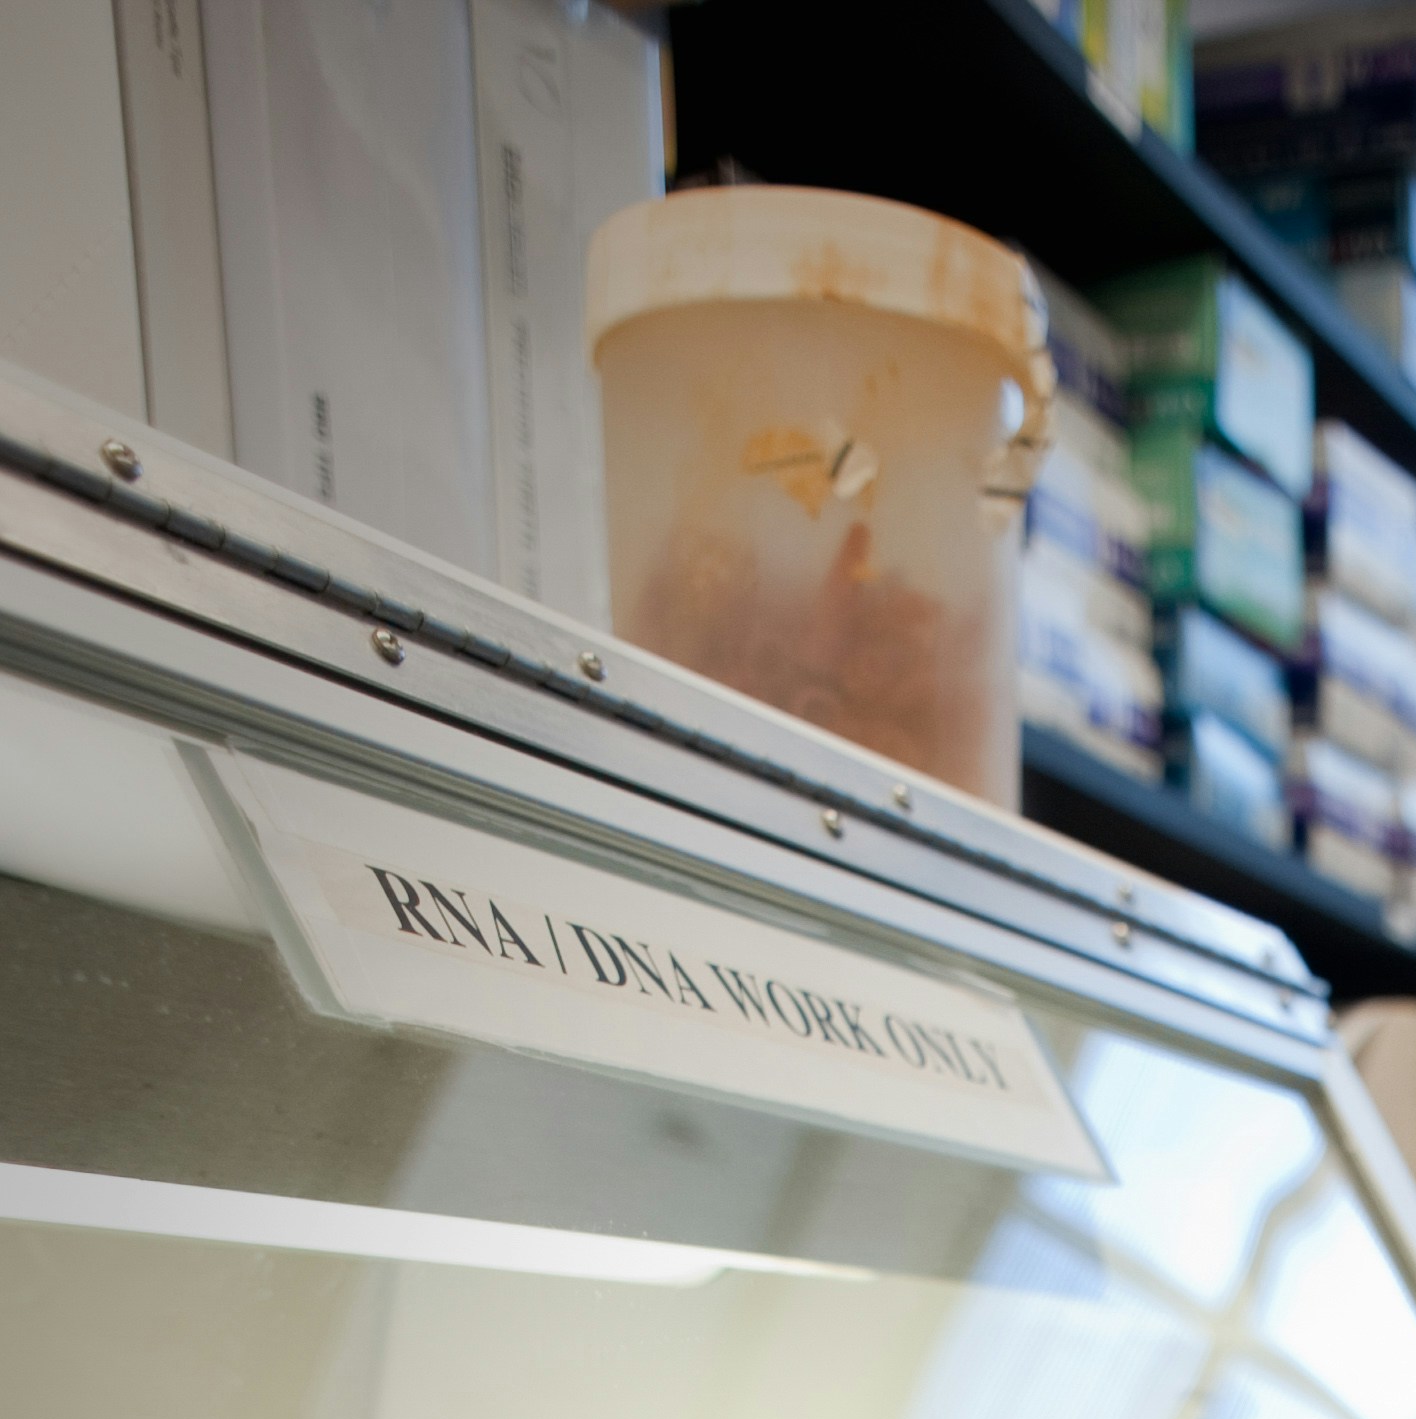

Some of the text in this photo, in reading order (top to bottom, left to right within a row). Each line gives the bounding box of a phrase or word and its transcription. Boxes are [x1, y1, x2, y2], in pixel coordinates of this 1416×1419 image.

[363, 863, 1008, 1091] RNA / DNA WORK ONLY
